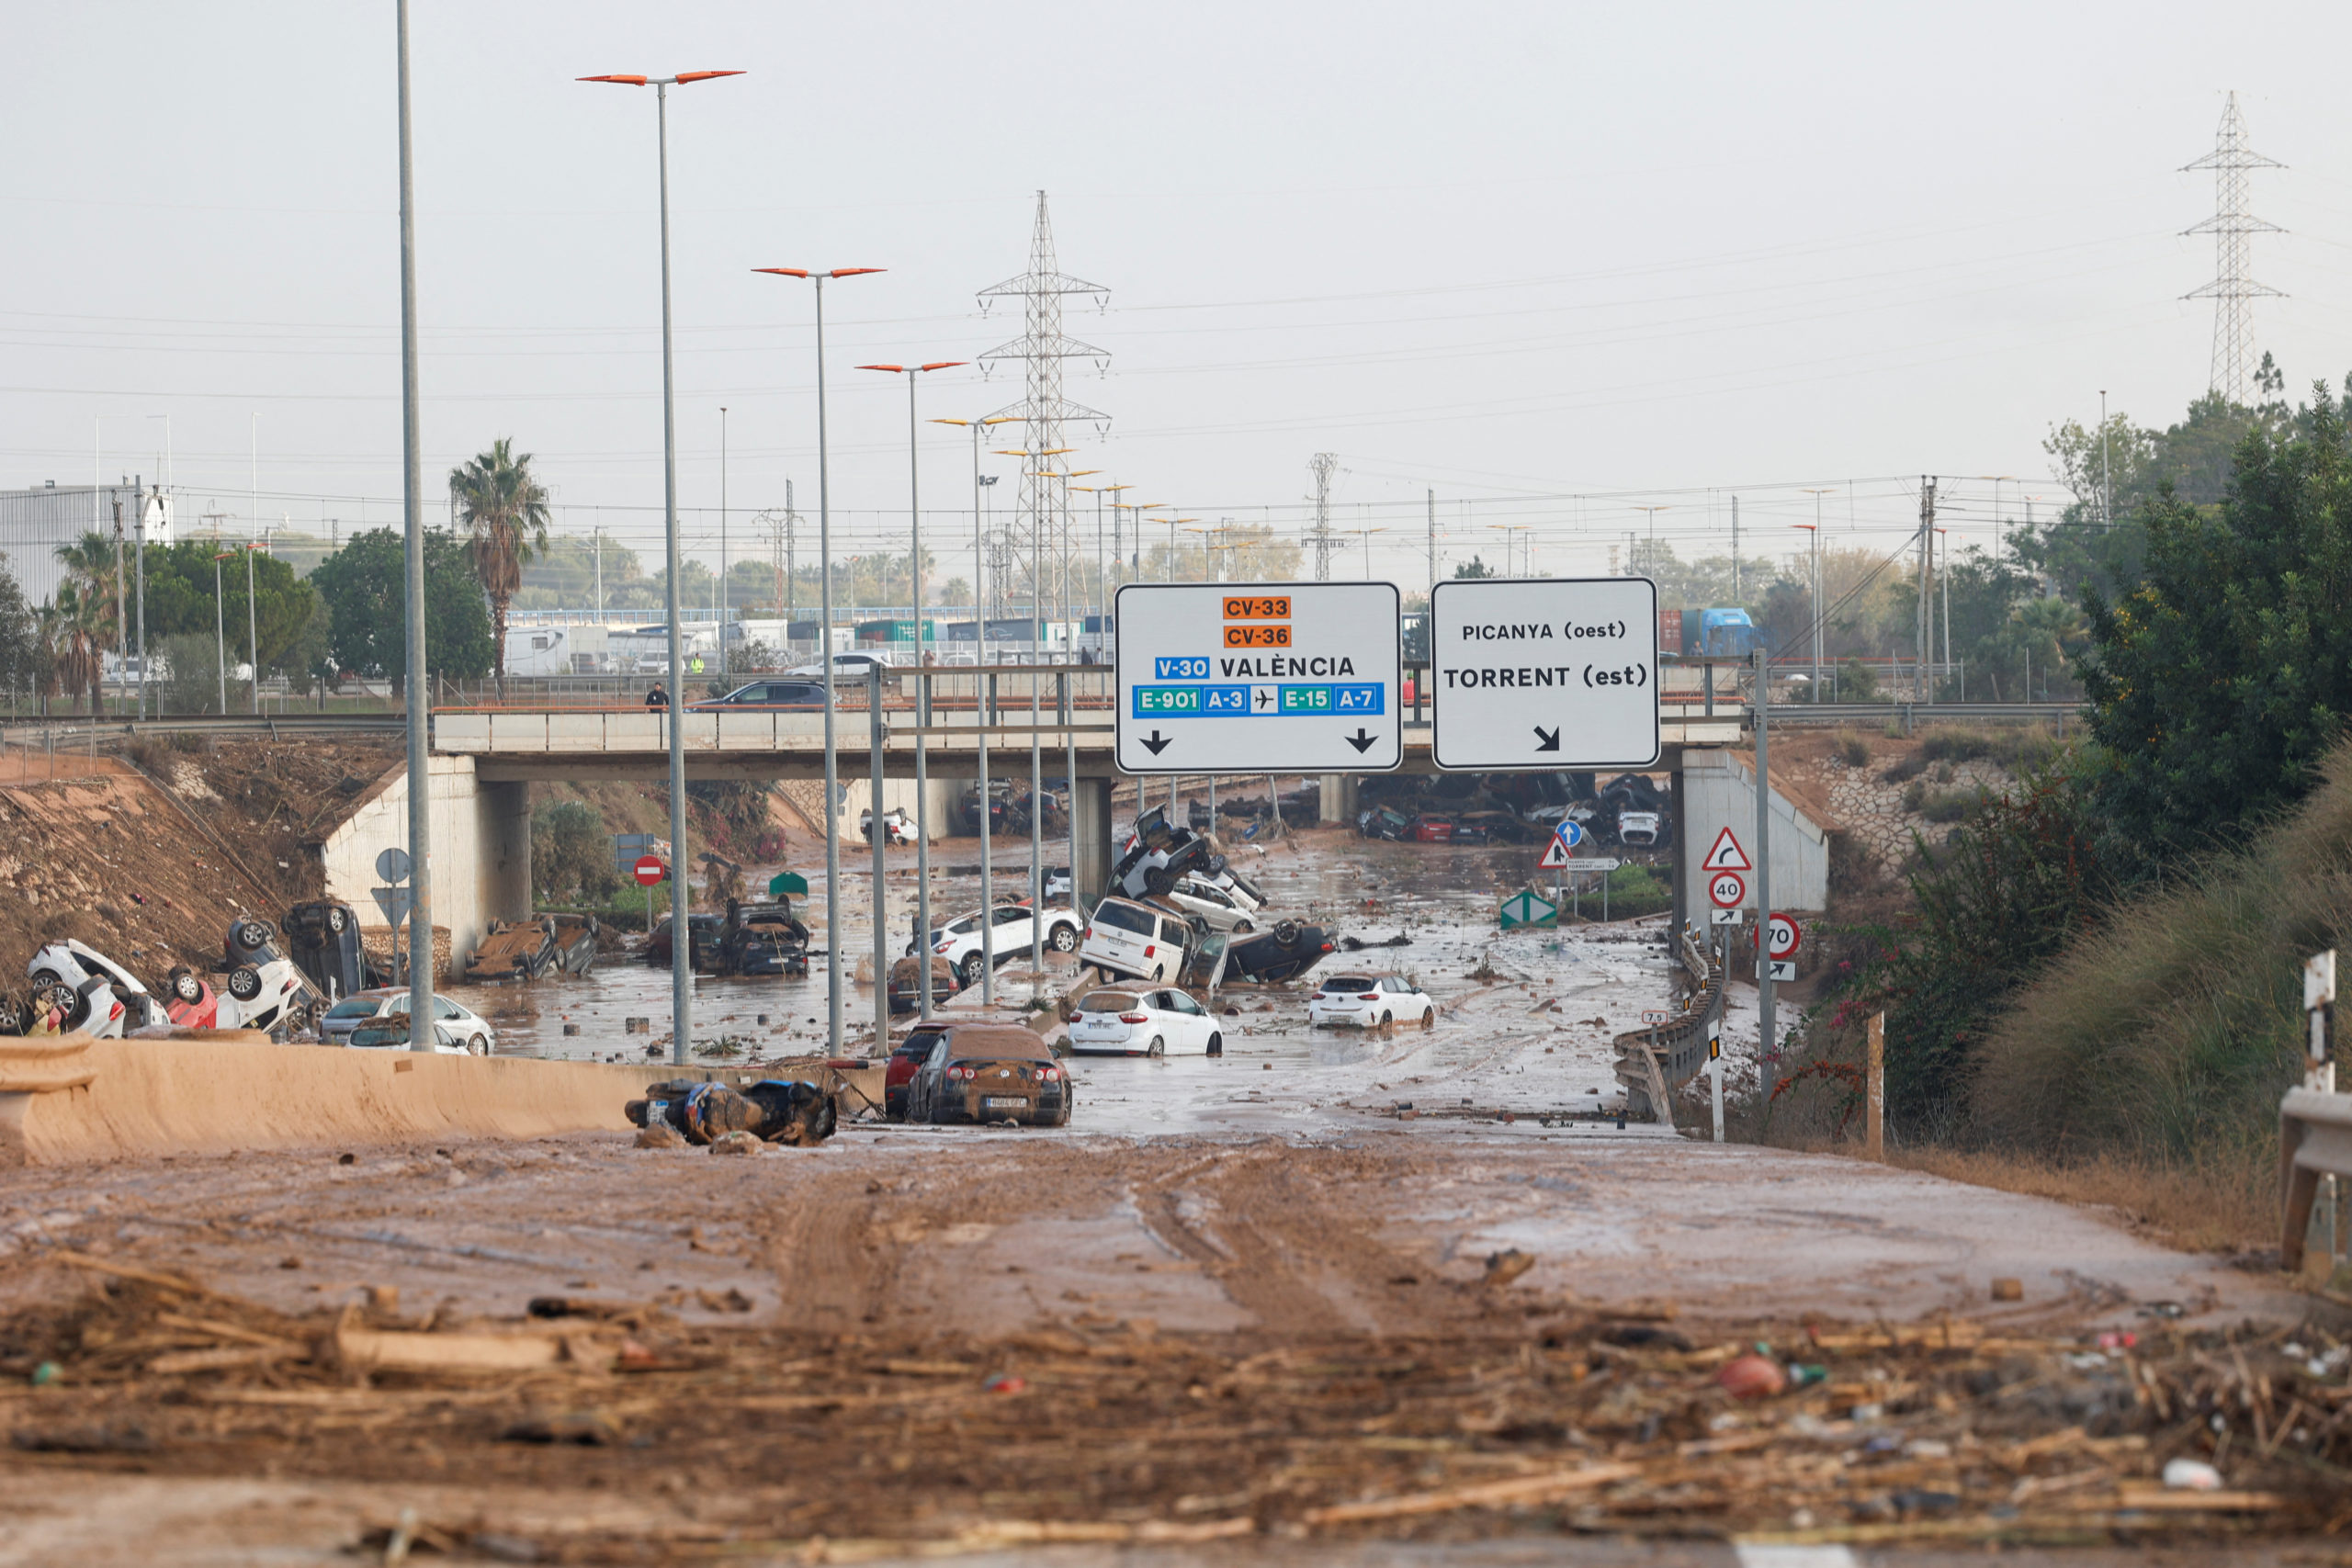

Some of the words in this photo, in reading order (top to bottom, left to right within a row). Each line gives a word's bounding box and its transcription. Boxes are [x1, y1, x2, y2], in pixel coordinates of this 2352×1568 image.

[1227, 600, 1288, 616] CV-33
[1227, 627, 1288, 645] CV-36
[1463, 624, 1554, 640] PICANYA
[1564, 620, 1626, 640] (oest)
[1159, 660, 1207, 677] V-30
[1220, 653, 1355, 677] VALÈNCIA
[1443, 667, 1570, 688] TORRENT
[1583, 662, 1647, 689] (est)
[1141, 691, 1197, 708] E-901
[1208, 691, 1243, 708] A-3
[1285, 690, 1328, 707] E-15
[1340, 690, 1373, 707] A-7
[1716, 883, 1738, 896] 40
